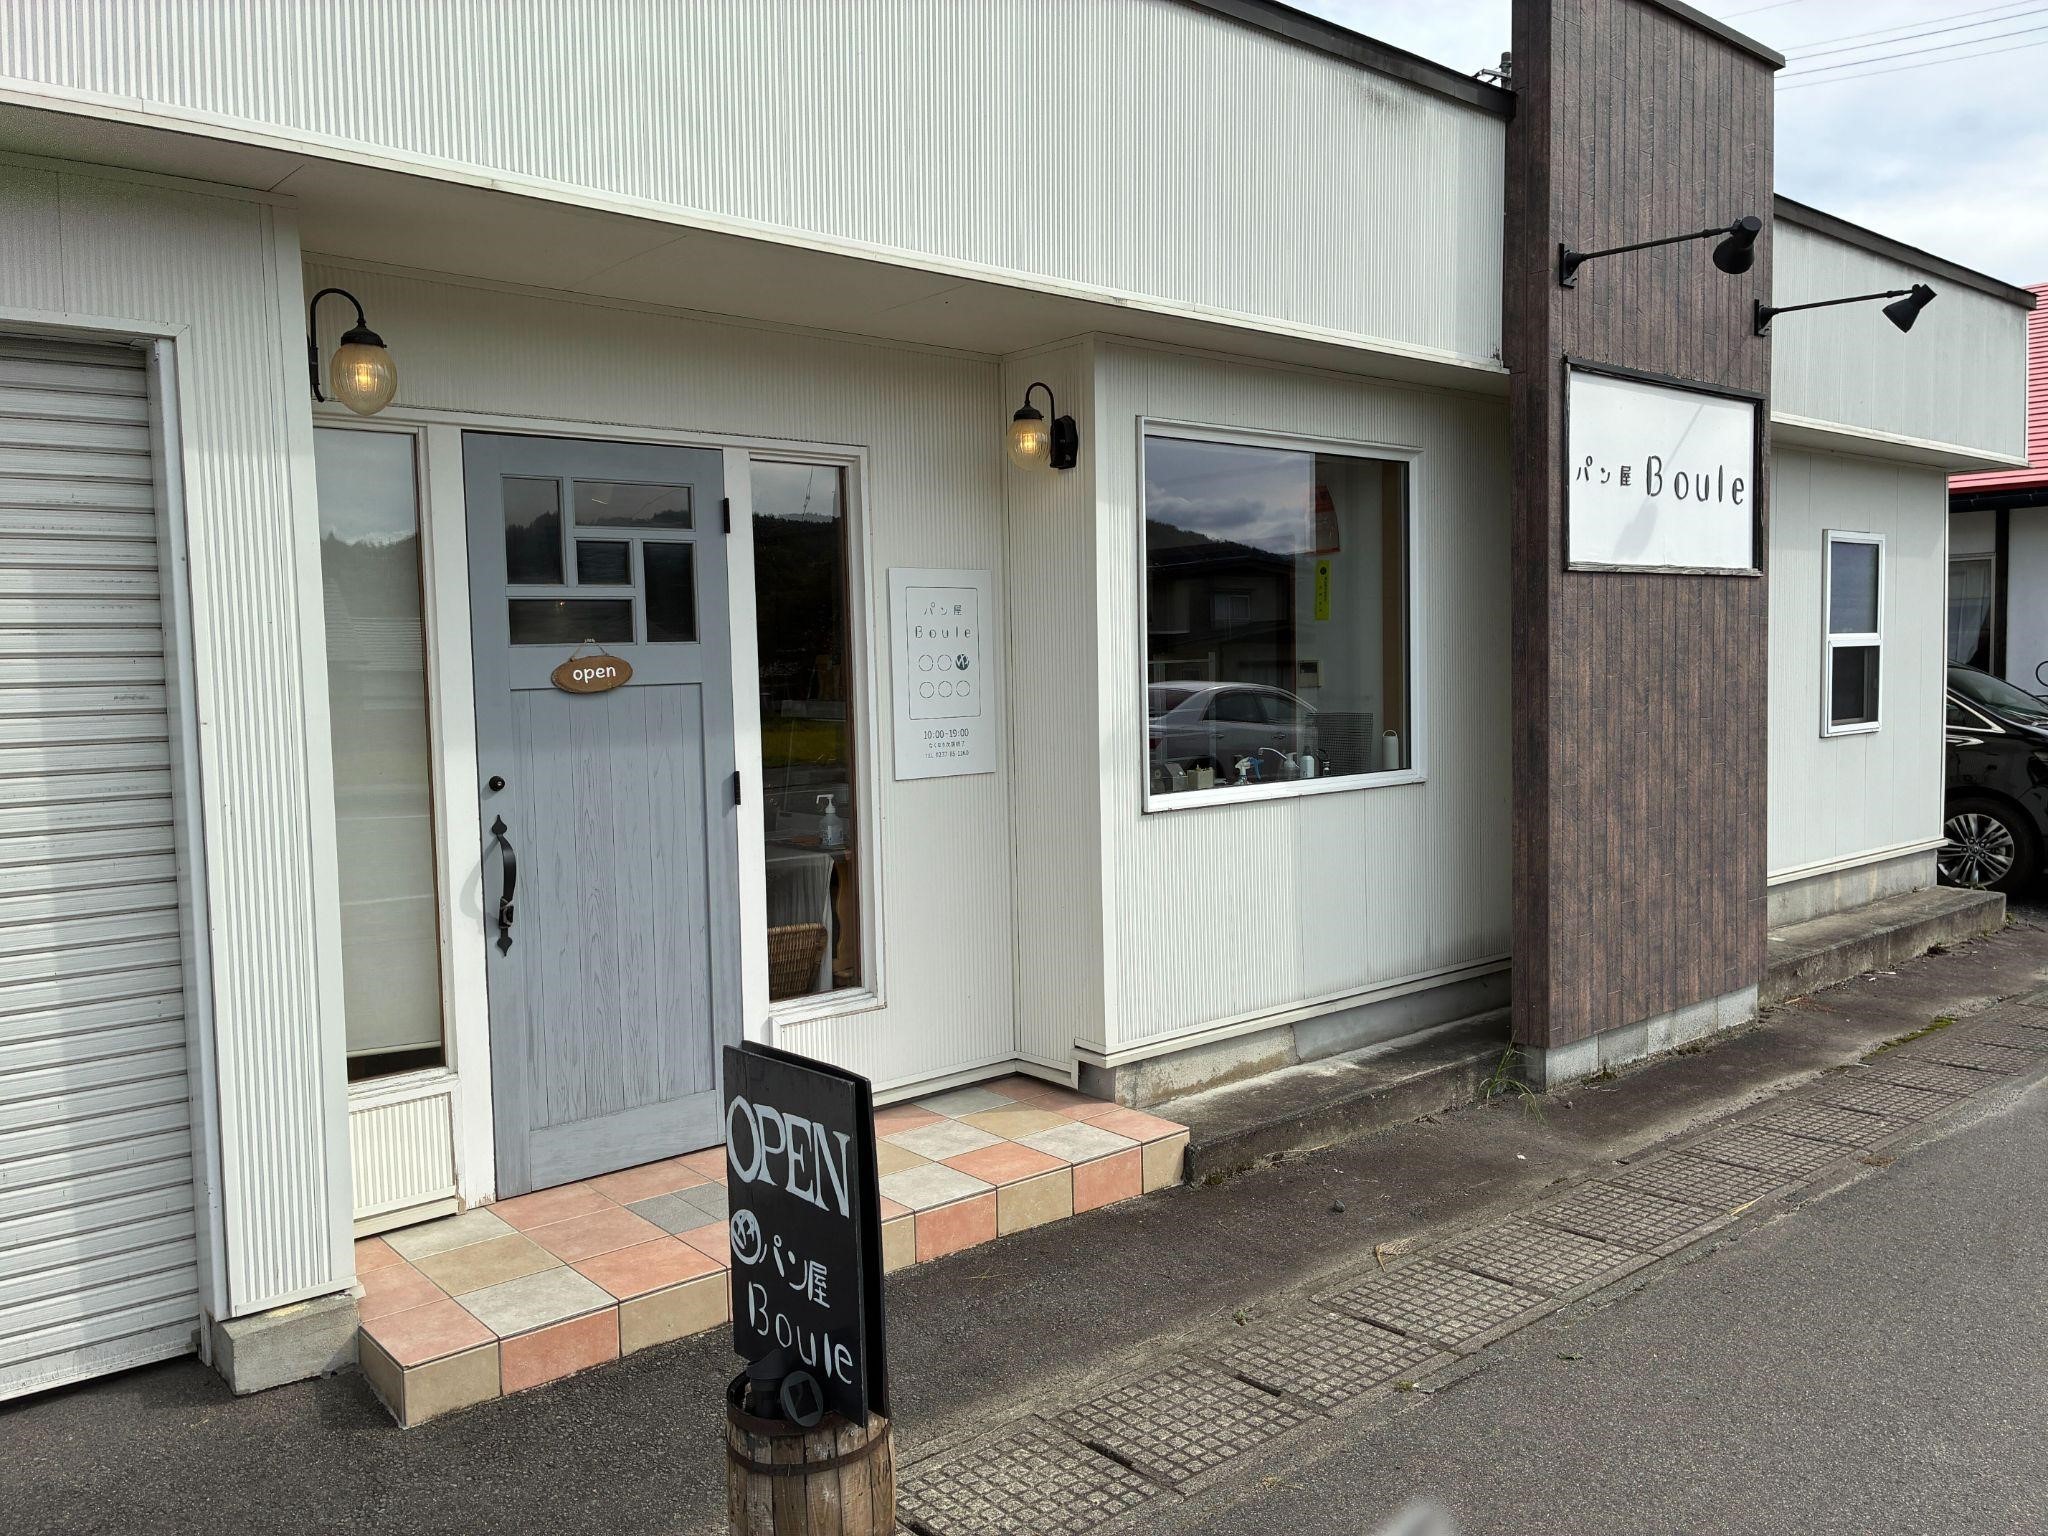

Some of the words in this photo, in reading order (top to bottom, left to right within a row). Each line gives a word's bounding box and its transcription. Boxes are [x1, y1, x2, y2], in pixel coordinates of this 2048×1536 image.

[1576, 455, 1631, 486] パン屋
[1646, 455, 1745, 505] Boule
[924, 601, 962, 616] パン屋
[915, 625, 971, 639] Boule
[573, 666, 616, 684] open
[924, 728, 969, 740] 10:00-19:00
[726, 1095, 851, 1219] OPEN
[758, 1234, 830, 1308] パン屋
[748, 1281, 853, 1385] Boule
